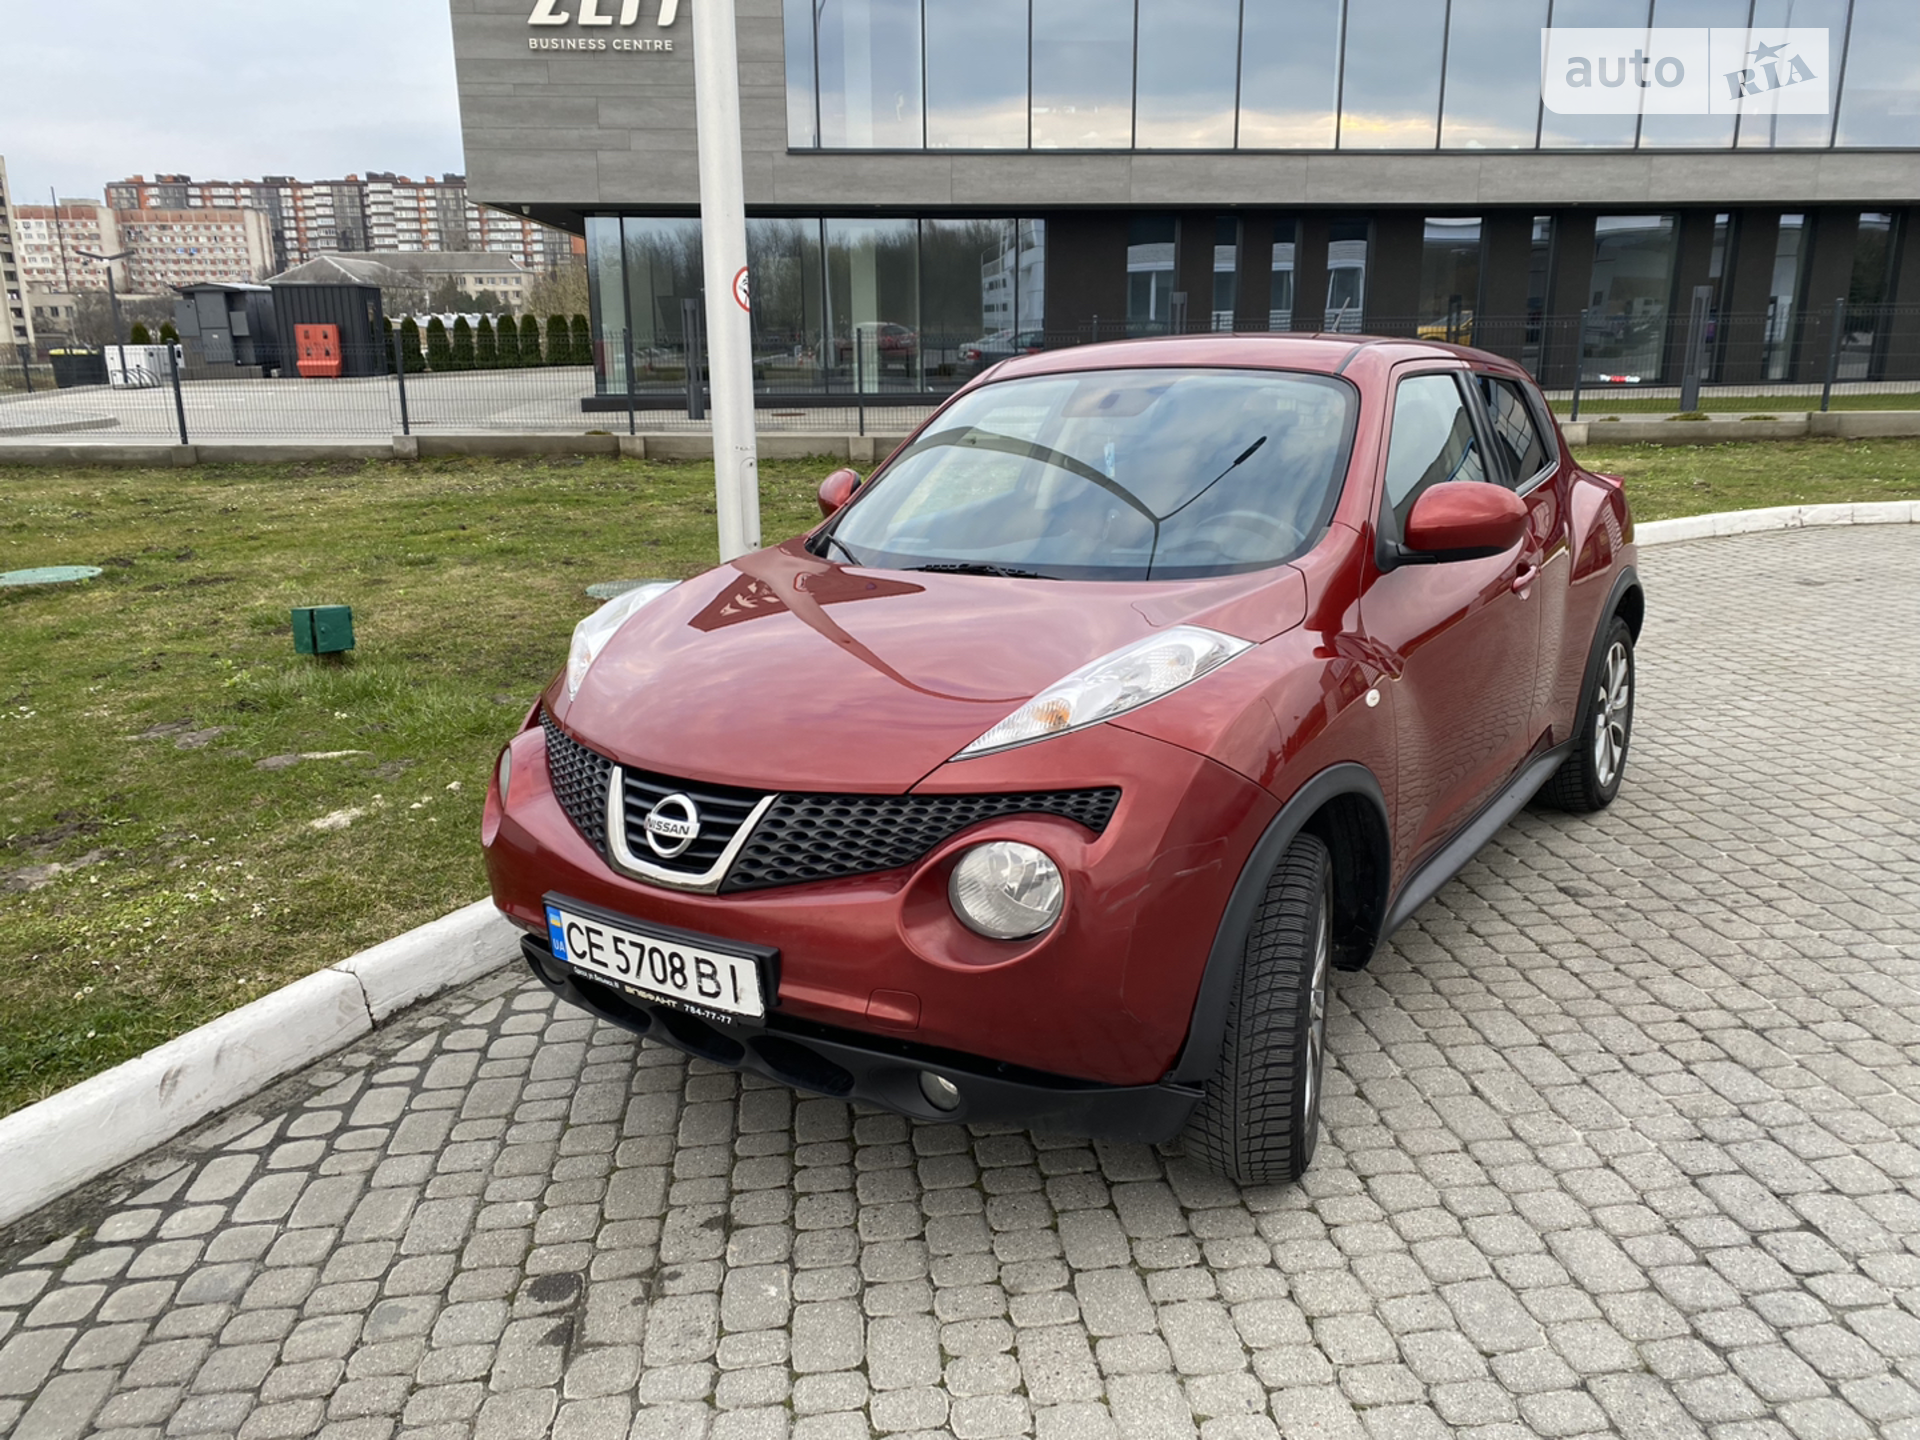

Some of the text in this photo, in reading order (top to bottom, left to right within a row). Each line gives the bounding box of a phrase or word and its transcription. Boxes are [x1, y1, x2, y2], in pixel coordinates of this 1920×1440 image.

[528, 38, 674, 51] BUSINESS CENTRE
[647, 816, 690, 836] NISSAN
[553, 938, 566, 953] UA
[566, 922, 609, 969] CE
[612, 935, 688, 990] 5708
